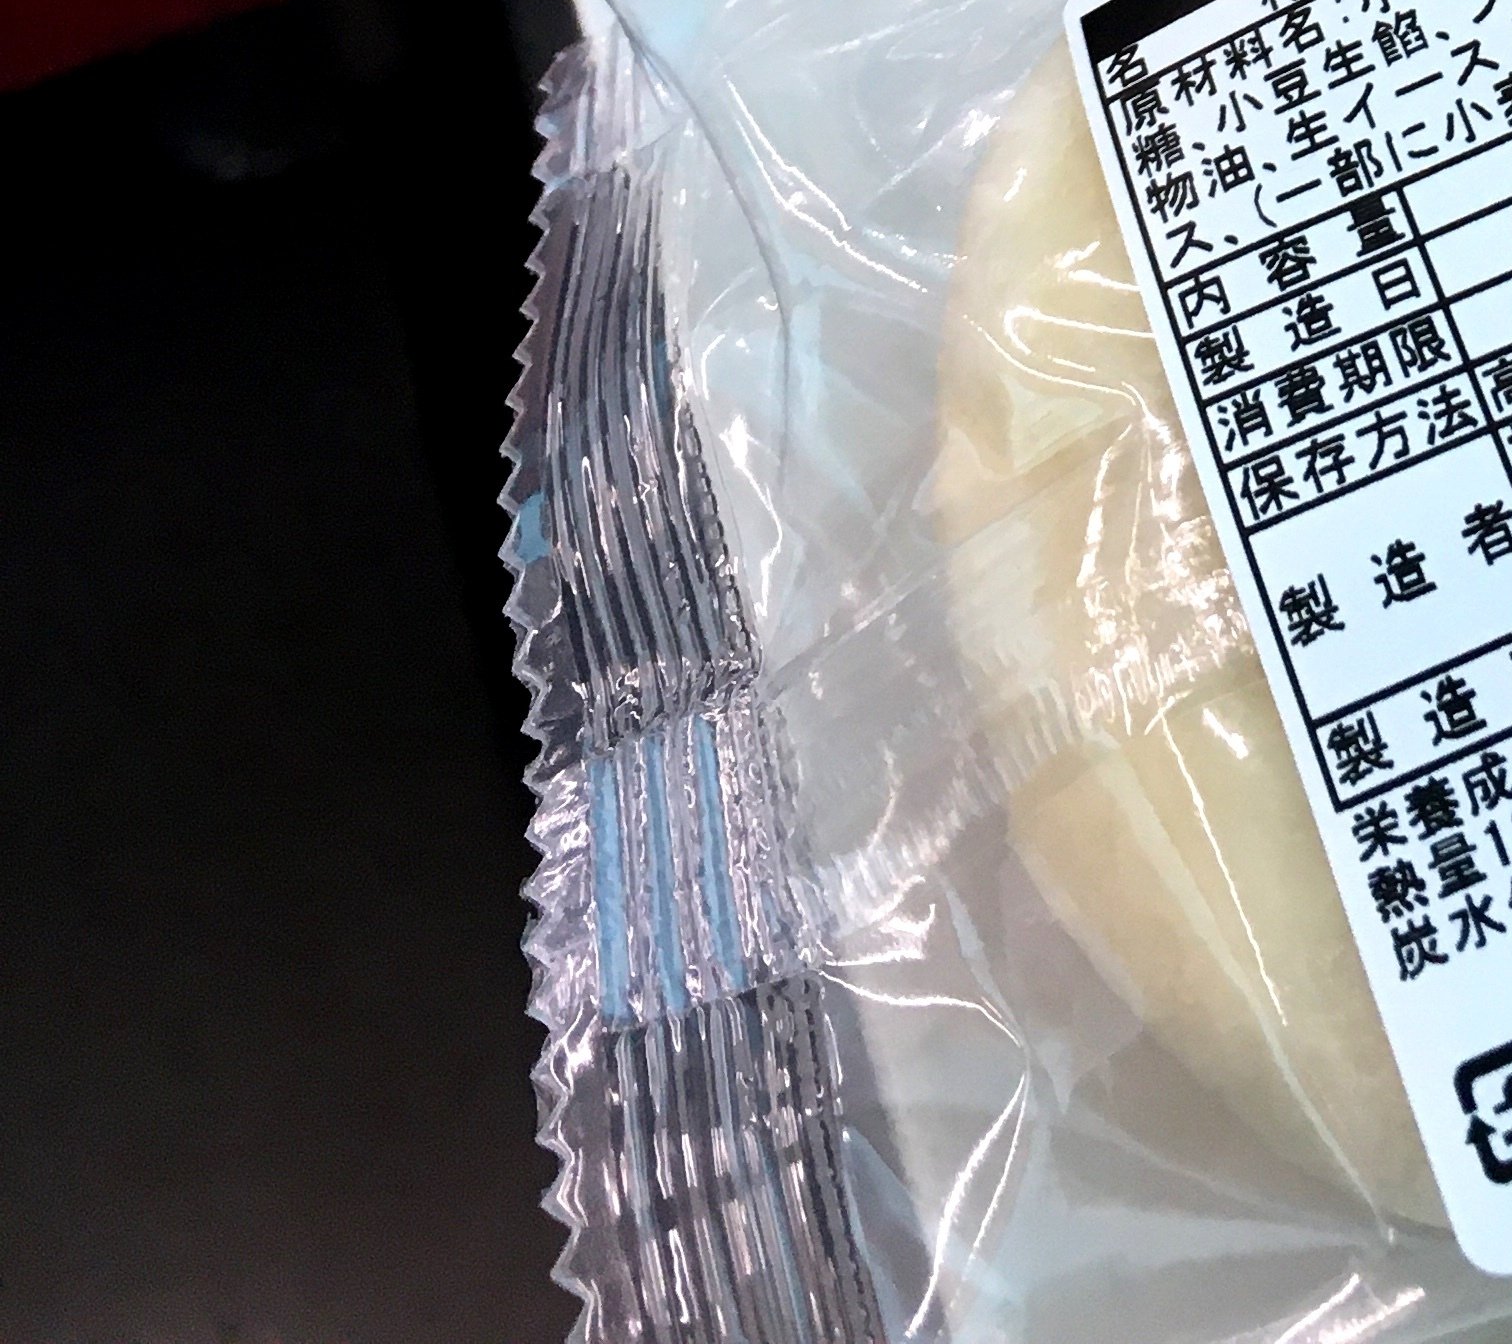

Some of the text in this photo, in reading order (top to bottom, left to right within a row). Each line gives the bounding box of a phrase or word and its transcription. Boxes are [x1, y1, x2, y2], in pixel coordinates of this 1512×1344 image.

[1216, 314, 1452, 452] 消費期限
[1239, 384, 1479, 522] 保存方法
